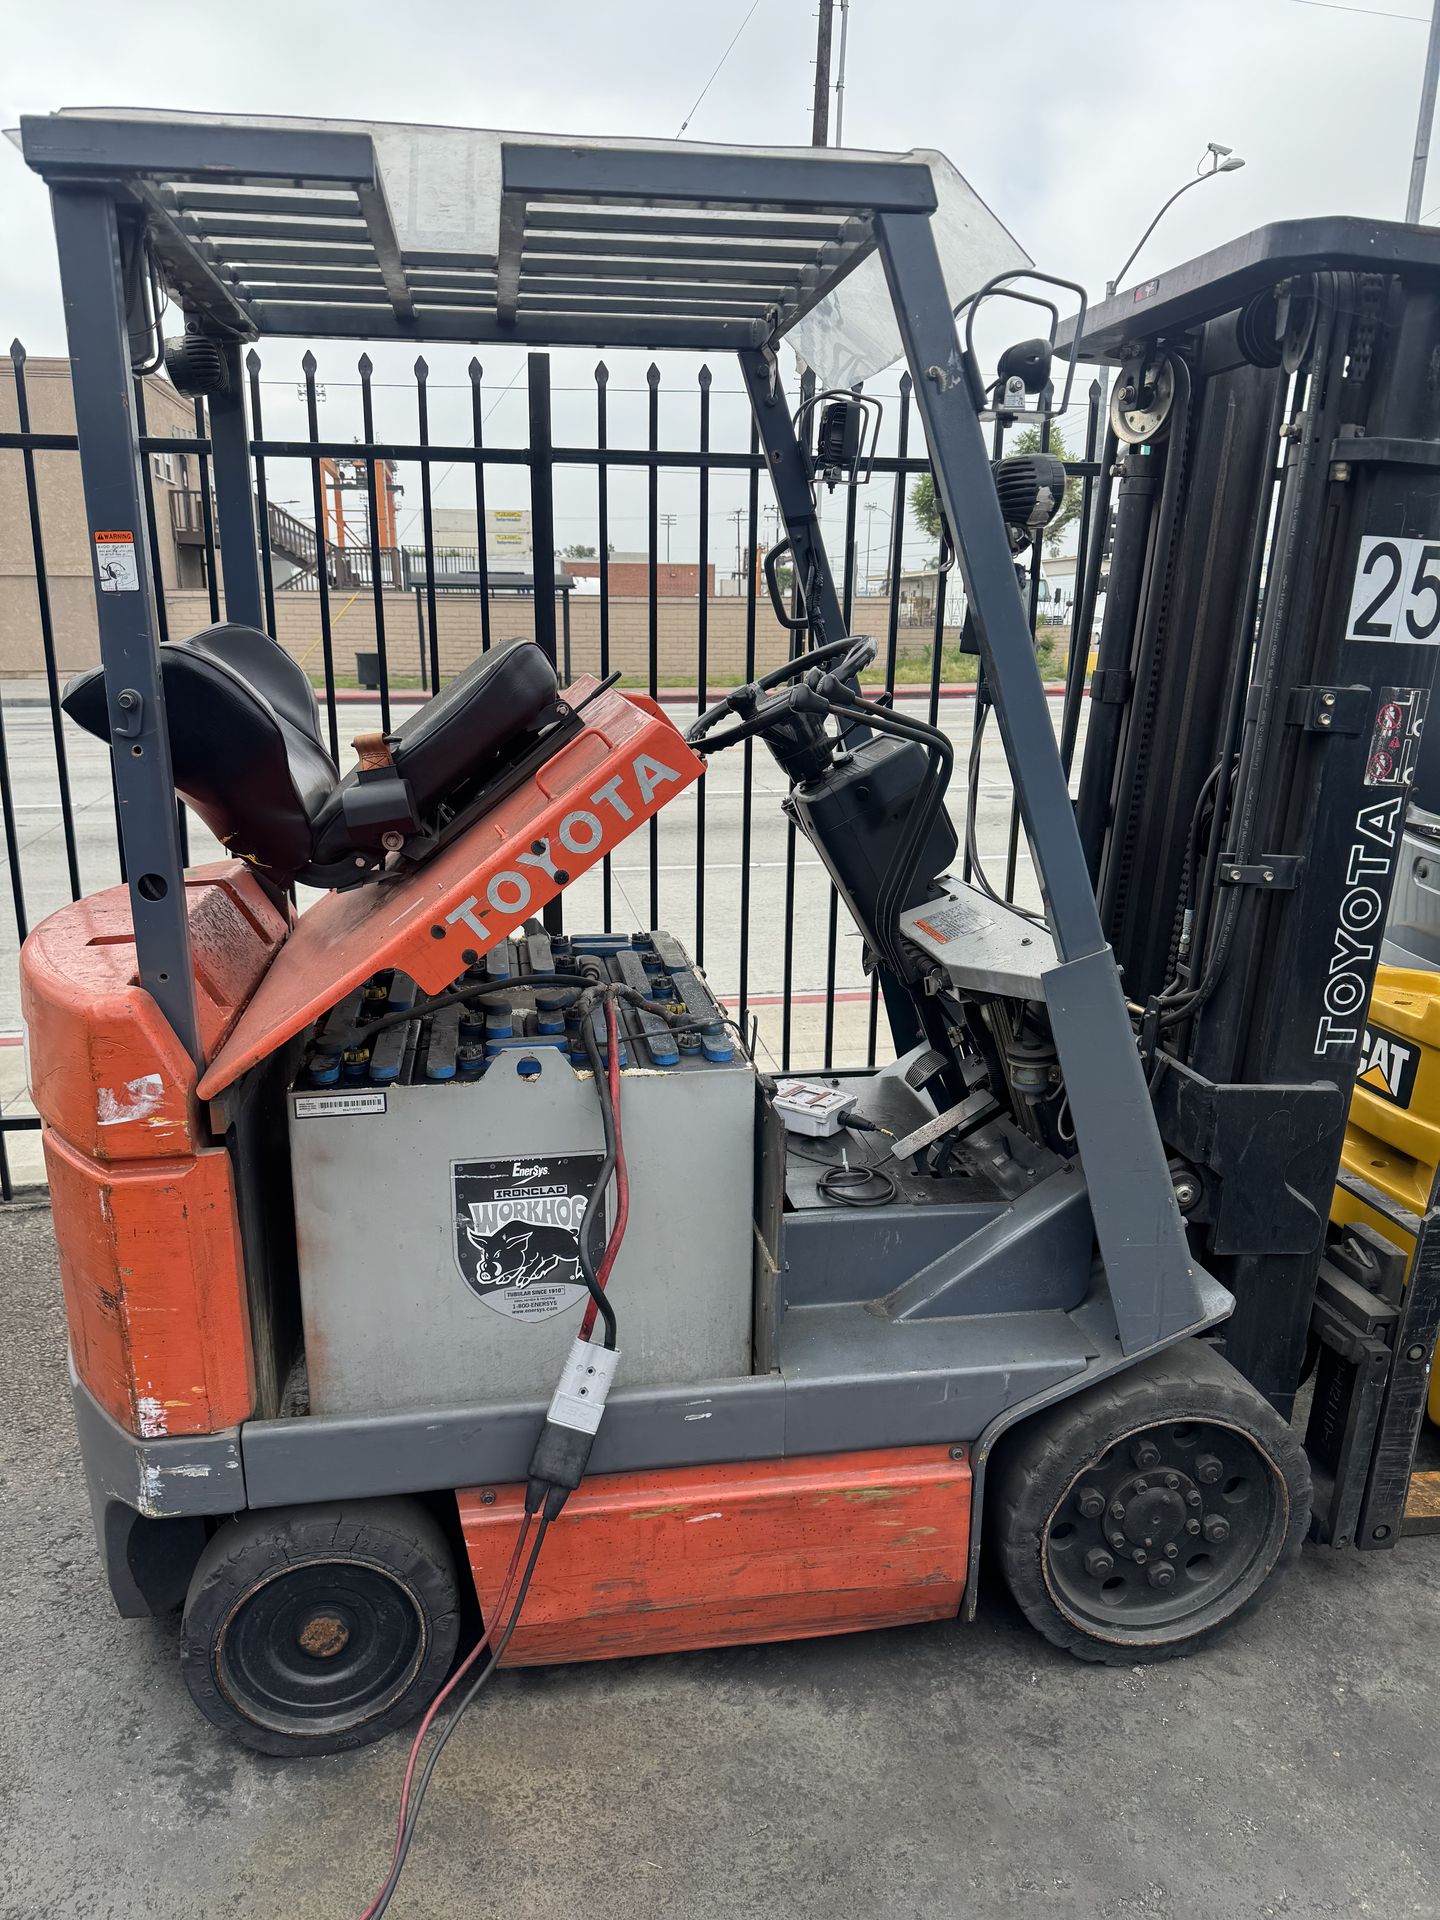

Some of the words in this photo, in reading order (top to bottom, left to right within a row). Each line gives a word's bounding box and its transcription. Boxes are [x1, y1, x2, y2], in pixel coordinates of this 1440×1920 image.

[1353, 542, 1440, 640] 25
[444, 753, 682, 941] TOYOTA
[1314, 797, 1402, 1055] TOYOTA
[469, 1195, 588, 1236] WORKHOG
[496, 1186, 566, 1198] IRONCLAD
